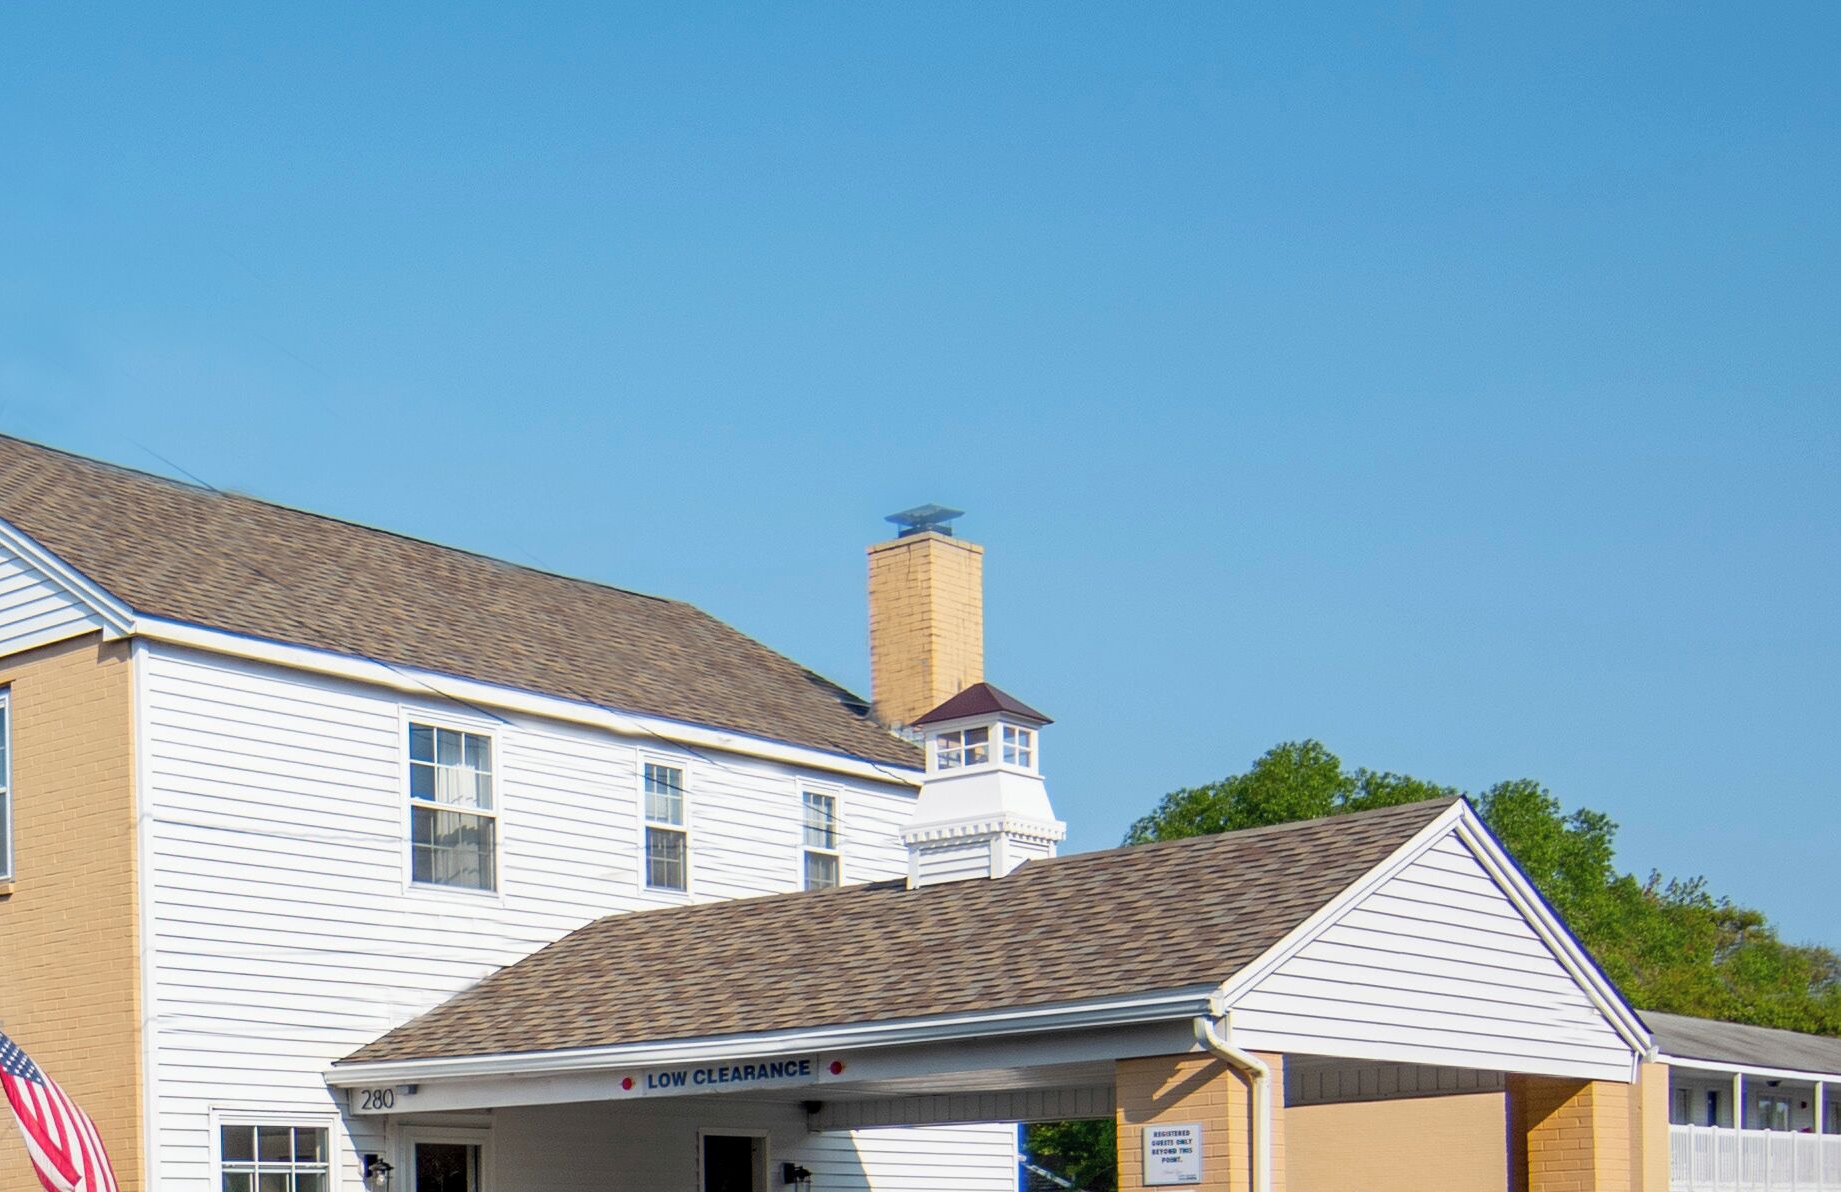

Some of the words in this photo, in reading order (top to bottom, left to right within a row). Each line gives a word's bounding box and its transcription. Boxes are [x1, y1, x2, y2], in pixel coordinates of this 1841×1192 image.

[648, 1071, 687, 1089] LOW
[693, 1060, 811, 1085] CLEARANCE
[361, 1088, 394, 1110] 280
[1153, 1130, 1190, 1138] REGISTERED
[1176, 1138, 1192, 1146] ONLY
[1179, 1147, 1193, 1155] THIS
